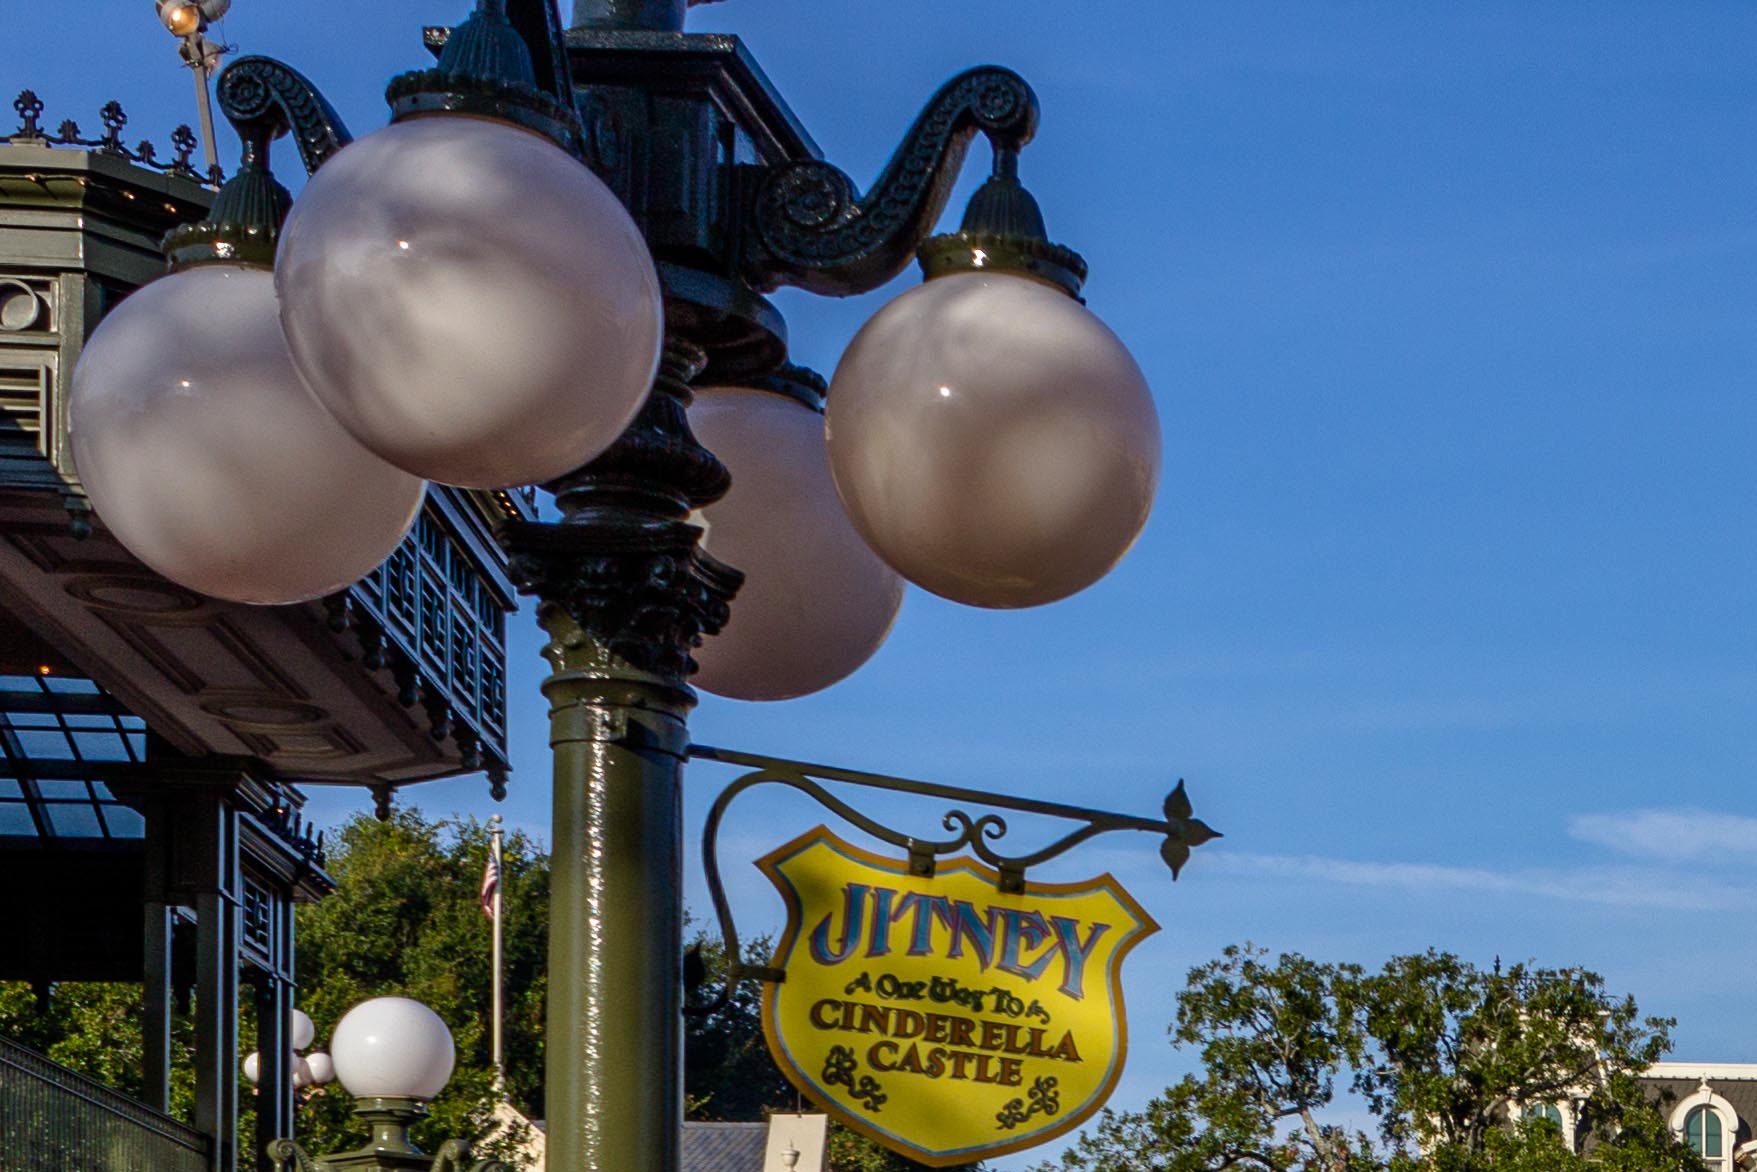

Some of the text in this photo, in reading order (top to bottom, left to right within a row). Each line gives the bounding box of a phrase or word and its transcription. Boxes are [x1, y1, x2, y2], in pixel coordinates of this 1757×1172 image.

[809, 882, 1112, 1001] JITNEY
[875, 973, 1025, 1018] One Way To
[809, 998, 1084, 1062] CINDERELLA
[866, 1040, 1024, 1087] CASTLE
